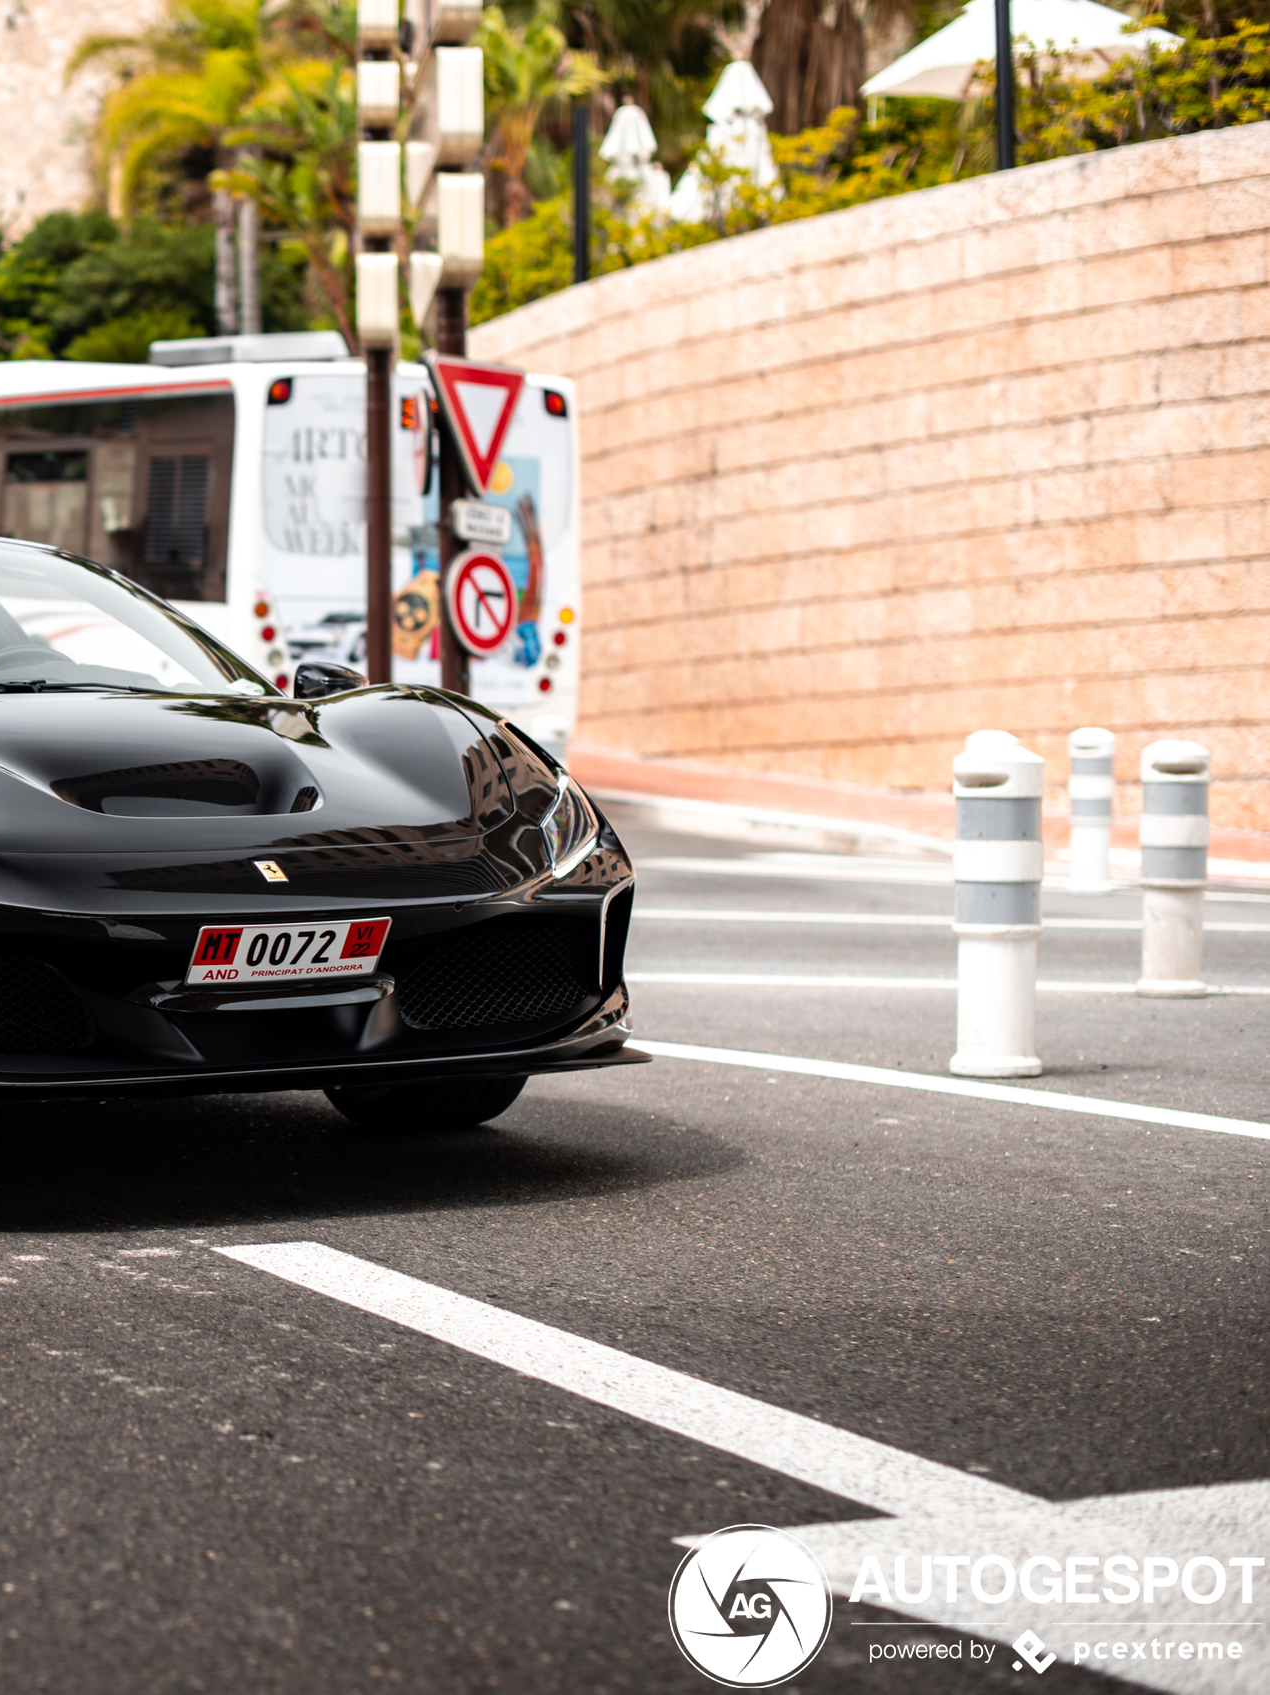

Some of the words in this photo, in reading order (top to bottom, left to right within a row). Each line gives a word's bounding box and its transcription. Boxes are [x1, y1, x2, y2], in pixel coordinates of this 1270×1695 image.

[357, 926, 374, 940] VI
[201, 933, 240, 960] MT
[246, 930, 337, 966] 0072
[348, 942, 371, 957] 22
[202, 969, 239, 981] AND
[251, 968, 304, 977] PRINCIPAT
[306, 964, 363, 974] D'ANDORRA
